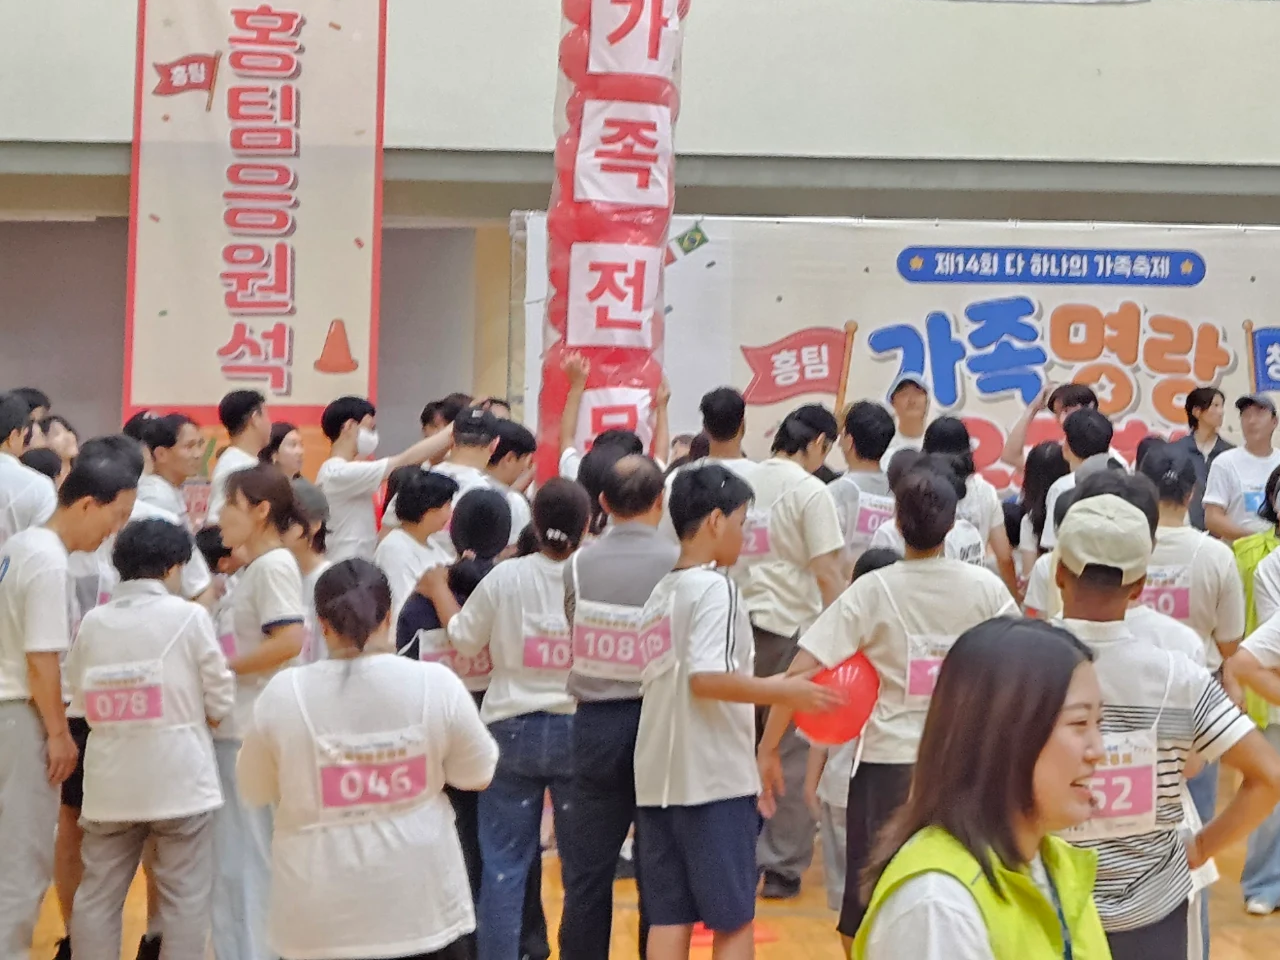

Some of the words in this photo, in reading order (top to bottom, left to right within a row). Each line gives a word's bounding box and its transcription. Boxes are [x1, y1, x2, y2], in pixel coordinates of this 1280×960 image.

[933, 252, 999, 276] 제14회
[1004, 253, 1026, 276] 다
[1029, 253, 1089, 277] 하나의
[771, 342, 829, 387] 홍팀
[536, 641, 570, 667] 10
[583, 632, 635, 662] 108
[96, 690, 149, 719] 078
[340, 764, 413, 801] 046
[1088, 775, 1134, 812] 52
